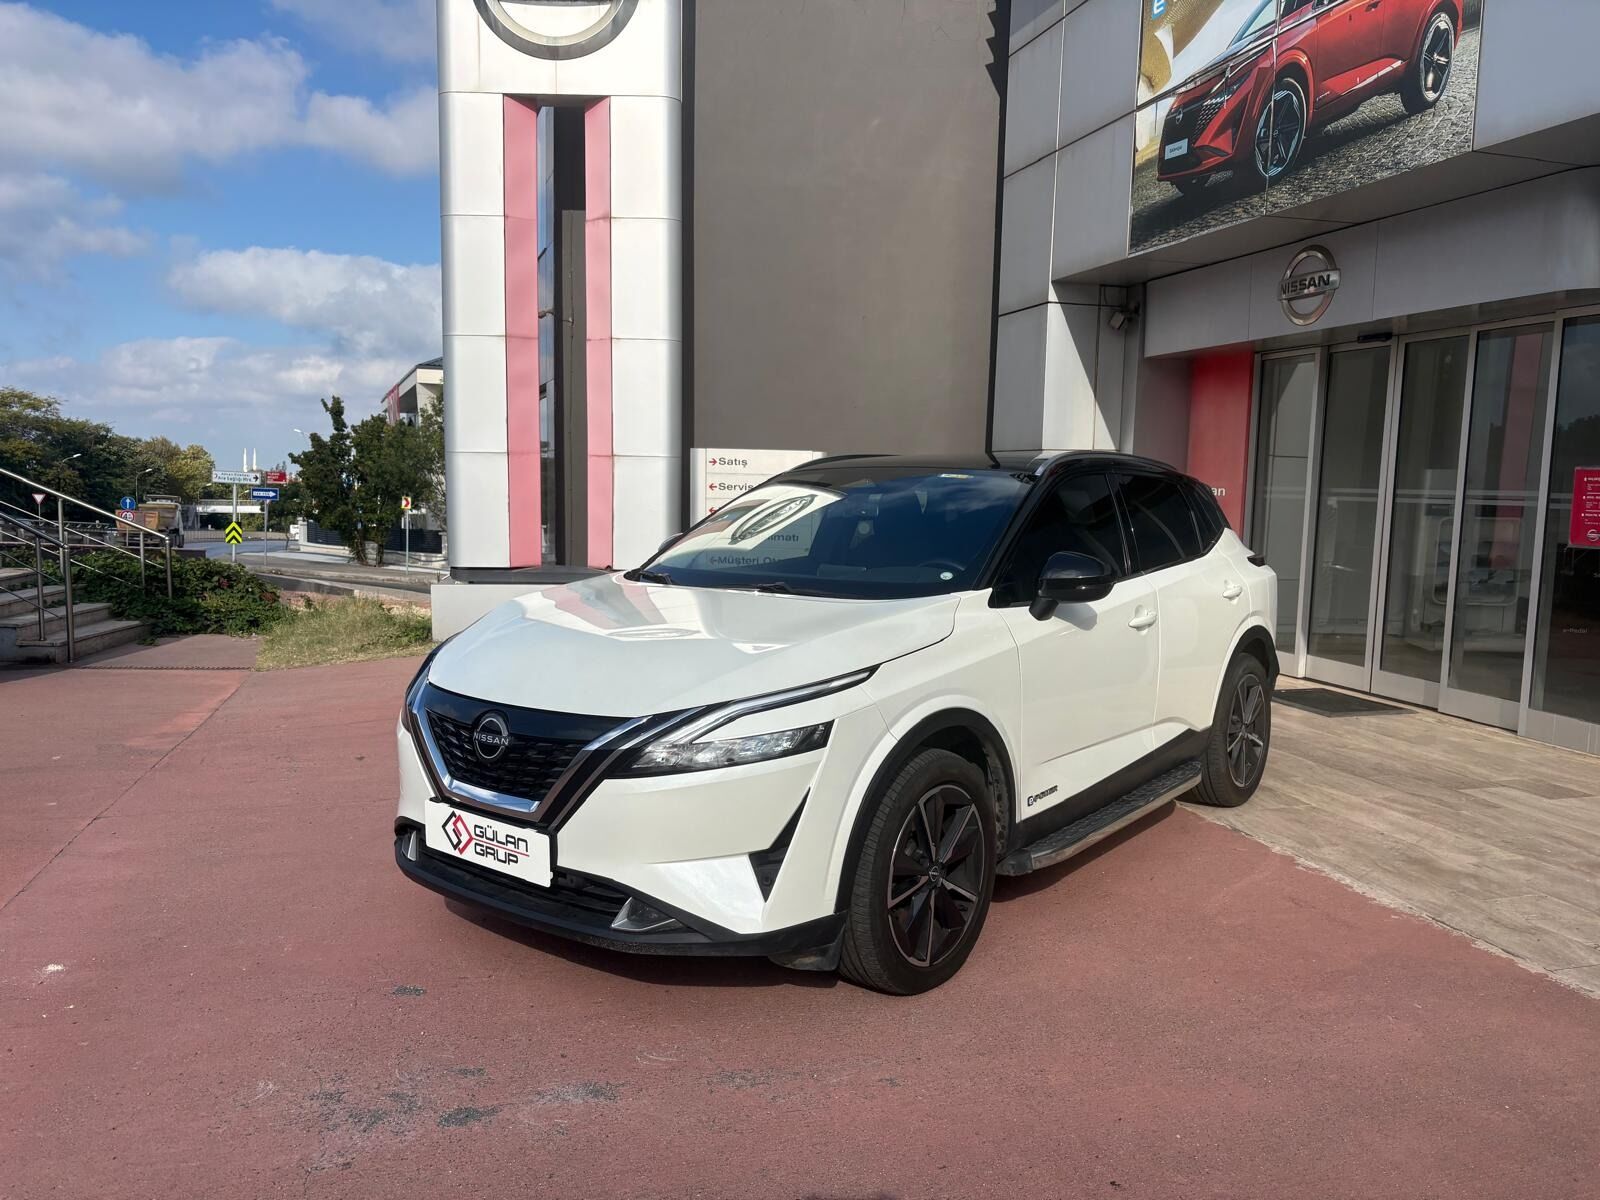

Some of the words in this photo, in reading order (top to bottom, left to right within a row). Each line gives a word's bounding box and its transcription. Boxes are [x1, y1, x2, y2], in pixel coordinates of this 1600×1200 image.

[1281, 274, 1331, 295] NISSAN
[718, 456, 748, 468] Satış
[718, 482, 754, 491] Servis
[1211, 487, 1226, 497] an
[718, 555, 759, 565] Müşteri
[473, 731, 509, 746] NISSAN
[474, 824, 529, 853] GÜLAN
[474, 842, 519, 865] GRUP
